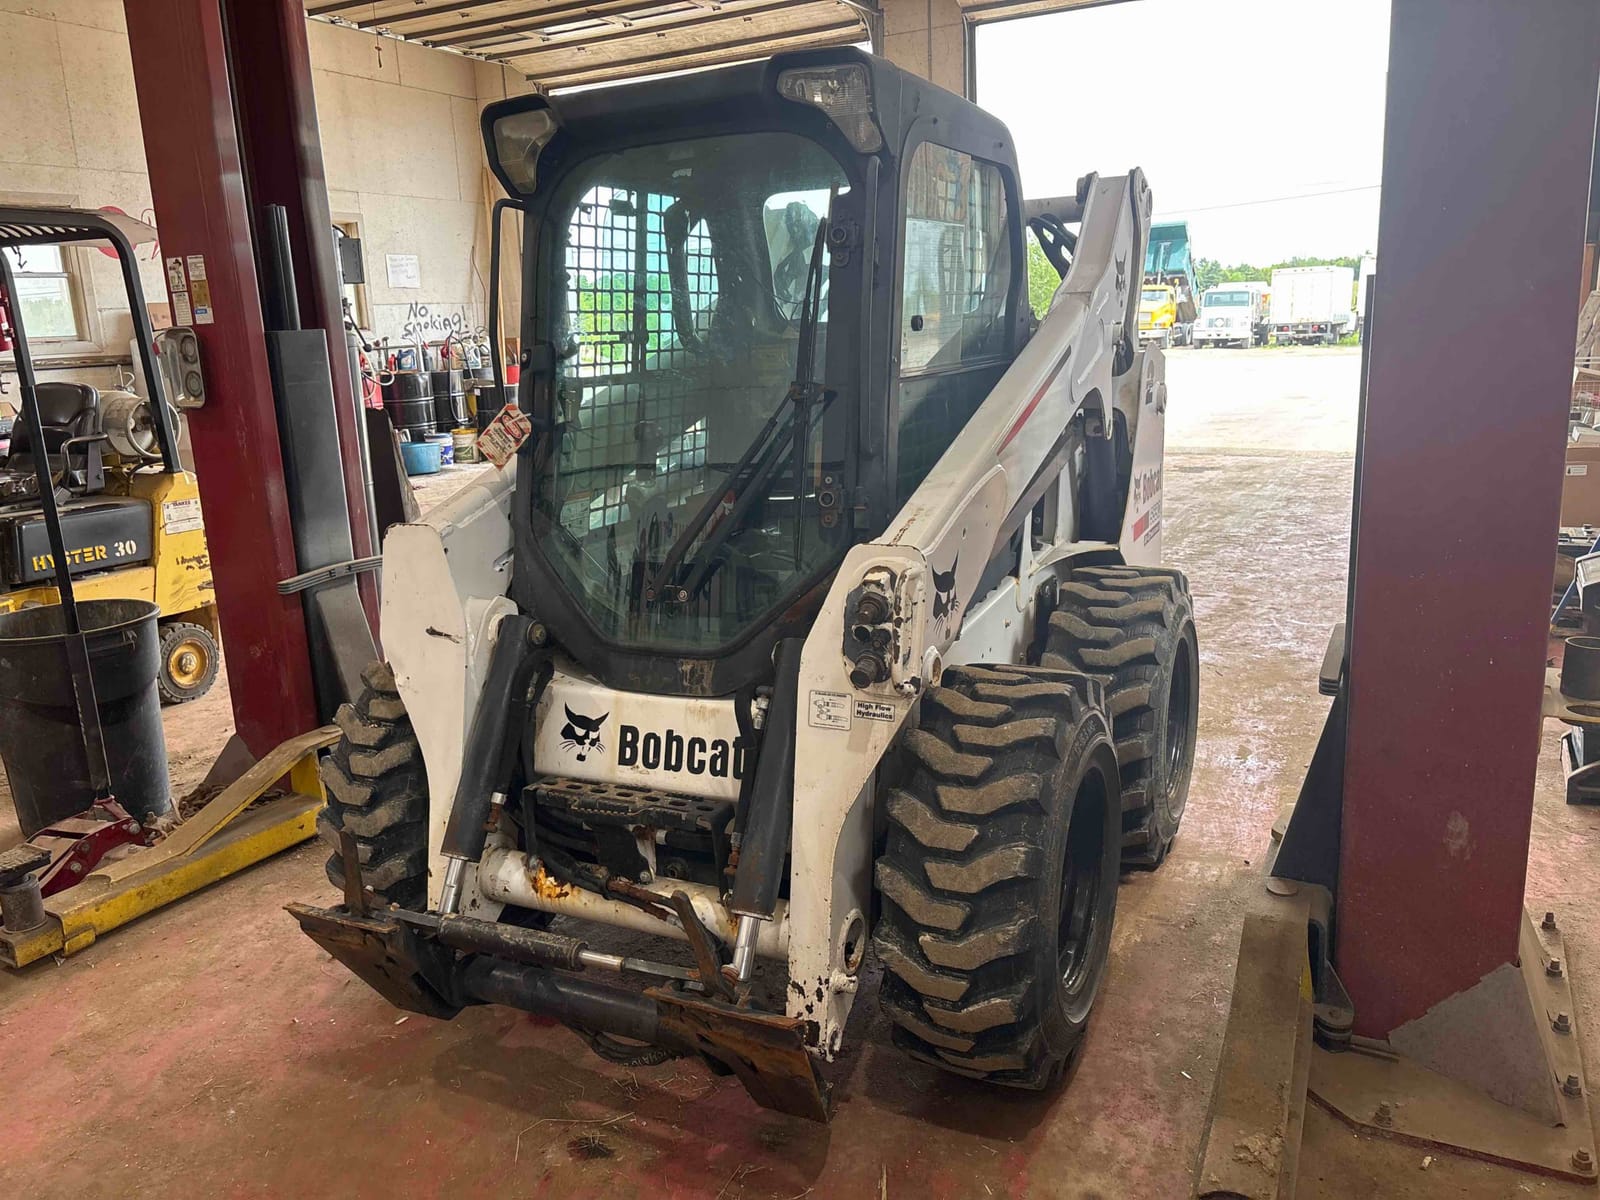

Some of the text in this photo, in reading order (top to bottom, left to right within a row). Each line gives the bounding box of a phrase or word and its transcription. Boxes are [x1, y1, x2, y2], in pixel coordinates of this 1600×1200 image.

[113, 539, 137, 557] 30
[857, 702, 892, 712] High Flow
[856, 709, 893, 720] Hydraulics
[618, 724, 745, 780] Bobcat
